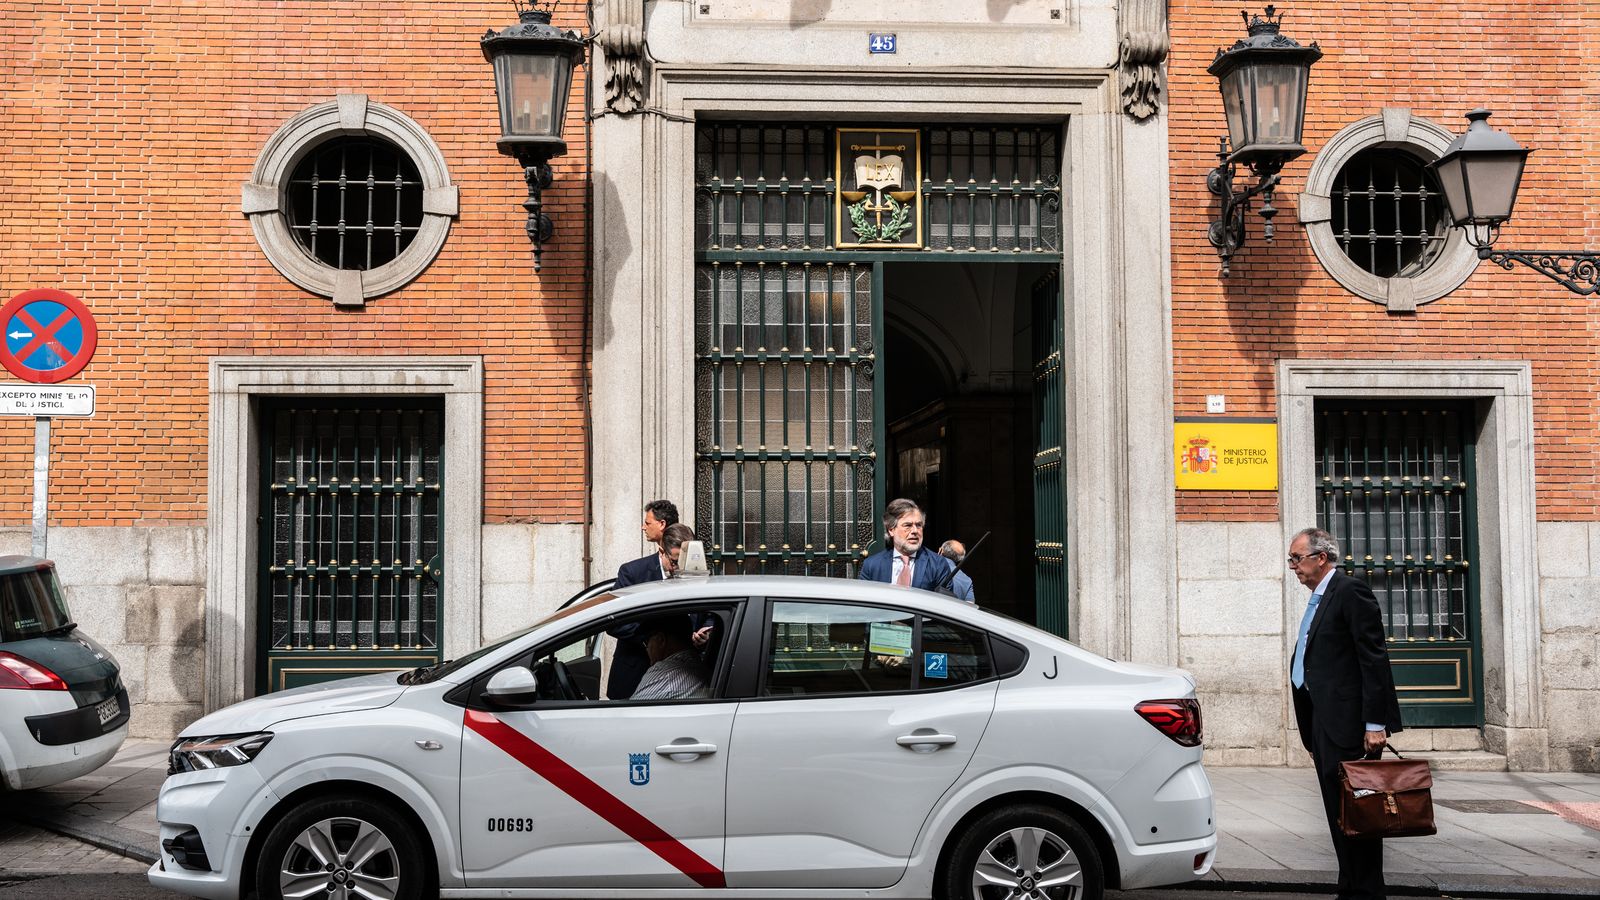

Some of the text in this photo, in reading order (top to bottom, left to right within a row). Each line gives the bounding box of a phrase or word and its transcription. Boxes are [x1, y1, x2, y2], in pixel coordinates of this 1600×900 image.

[872, 36, 893, 50] 45
[865, 162, 895, 181] LEX
[1236, 457, 1269, 466] JUSTICIA
[1043, 656, 1058, 679] J
[488, 818, 533, 832] 00693
